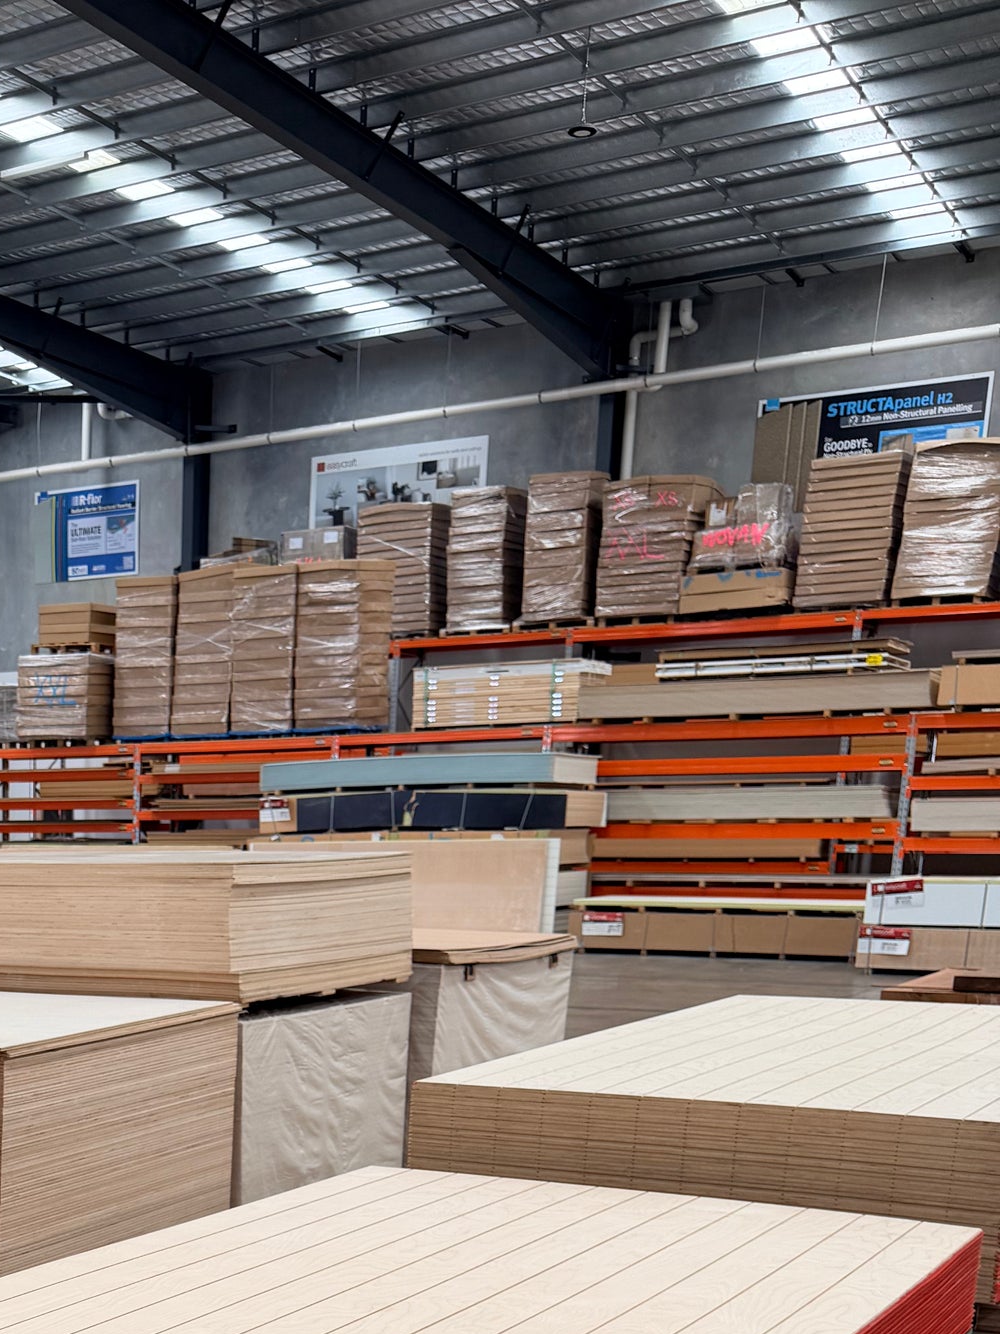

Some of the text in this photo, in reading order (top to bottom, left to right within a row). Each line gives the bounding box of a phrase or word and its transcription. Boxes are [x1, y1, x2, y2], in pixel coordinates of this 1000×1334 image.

[827, 391, 953, 418] STRUCTApanel H2
[883, 406, 937, 421] Non-Structural
[937, 403, 973, 415] Panelling
[824, 438, 868, 452] GOODBYE
[655, 490, 678, 507] XS
